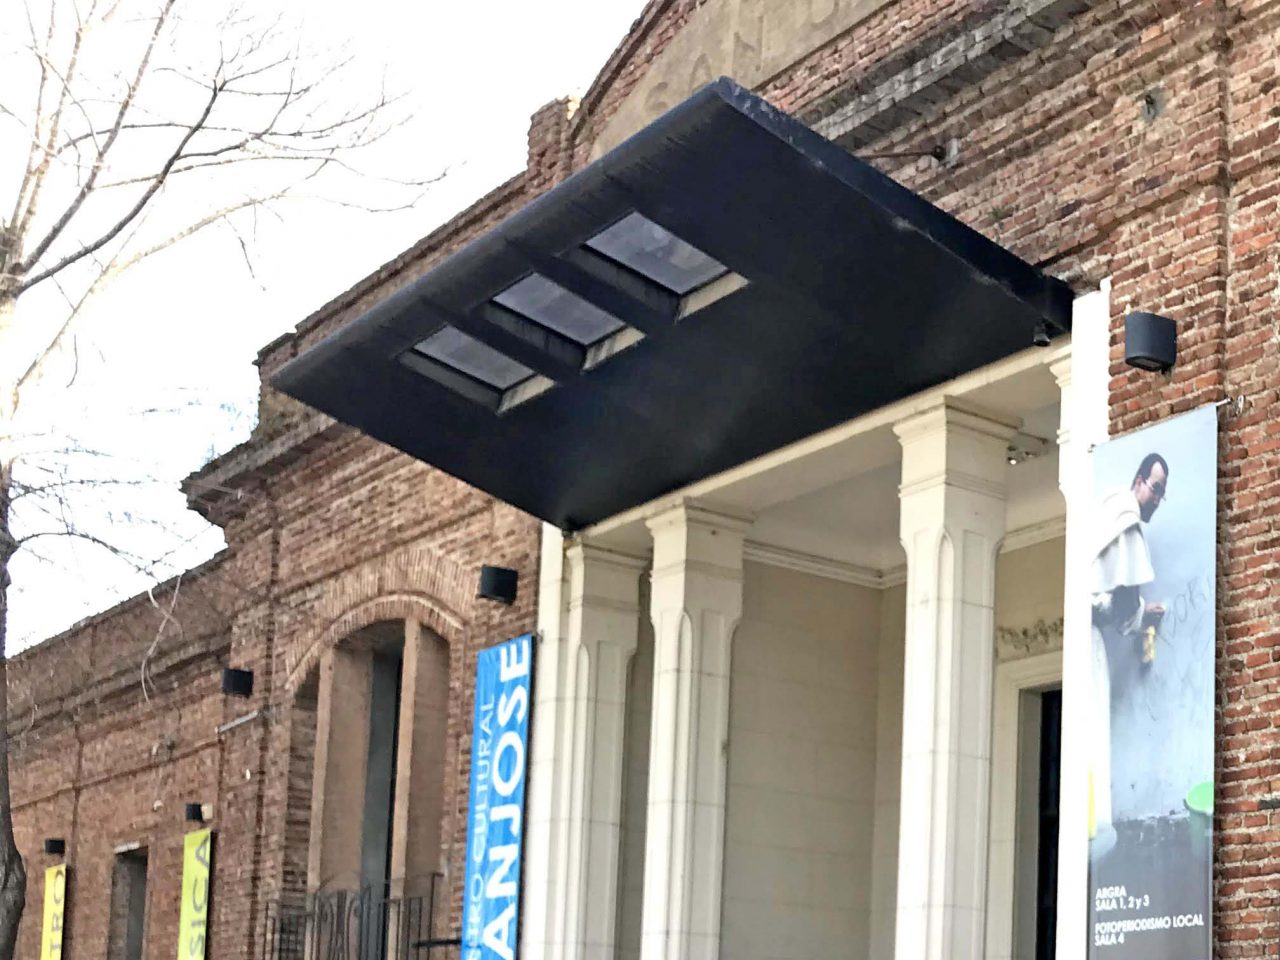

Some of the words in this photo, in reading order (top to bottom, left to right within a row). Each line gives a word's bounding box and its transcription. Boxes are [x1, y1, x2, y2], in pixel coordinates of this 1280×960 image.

[473, 692, 495, 863] CULTURAL
[1095, 886, 1127, 899] ARGRA
[1095, 899, 1117, 911] SALA
[1128, 896, 1134, 907] 2
[1135, 898, 1142, 909] y
[1143, 895, 1150, 906] 3
[1095, 917, 1171, 934] FOTOPERIODISMO
[1173, 914, 1204, 928] LOCAL
[1095, 935, 1117, 946] SALA
[1118, 933, 1124, 944] 4
